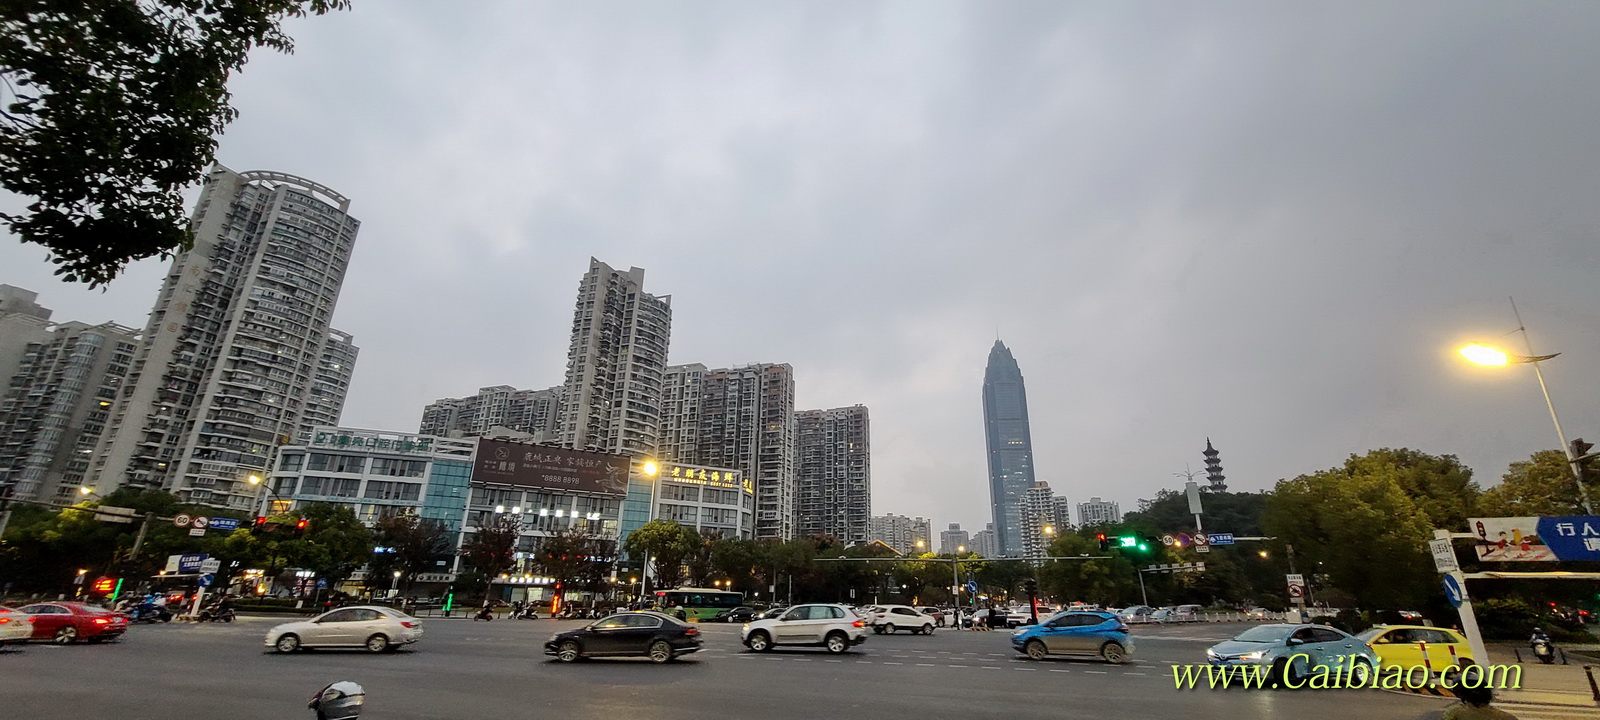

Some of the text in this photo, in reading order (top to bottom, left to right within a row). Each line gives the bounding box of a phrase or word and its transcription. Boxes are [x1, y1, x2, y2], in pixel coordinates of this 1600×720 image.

[671, 466, 734, 483] 老朋友海鲜
[1556, 522, 1600, 537] 行人
